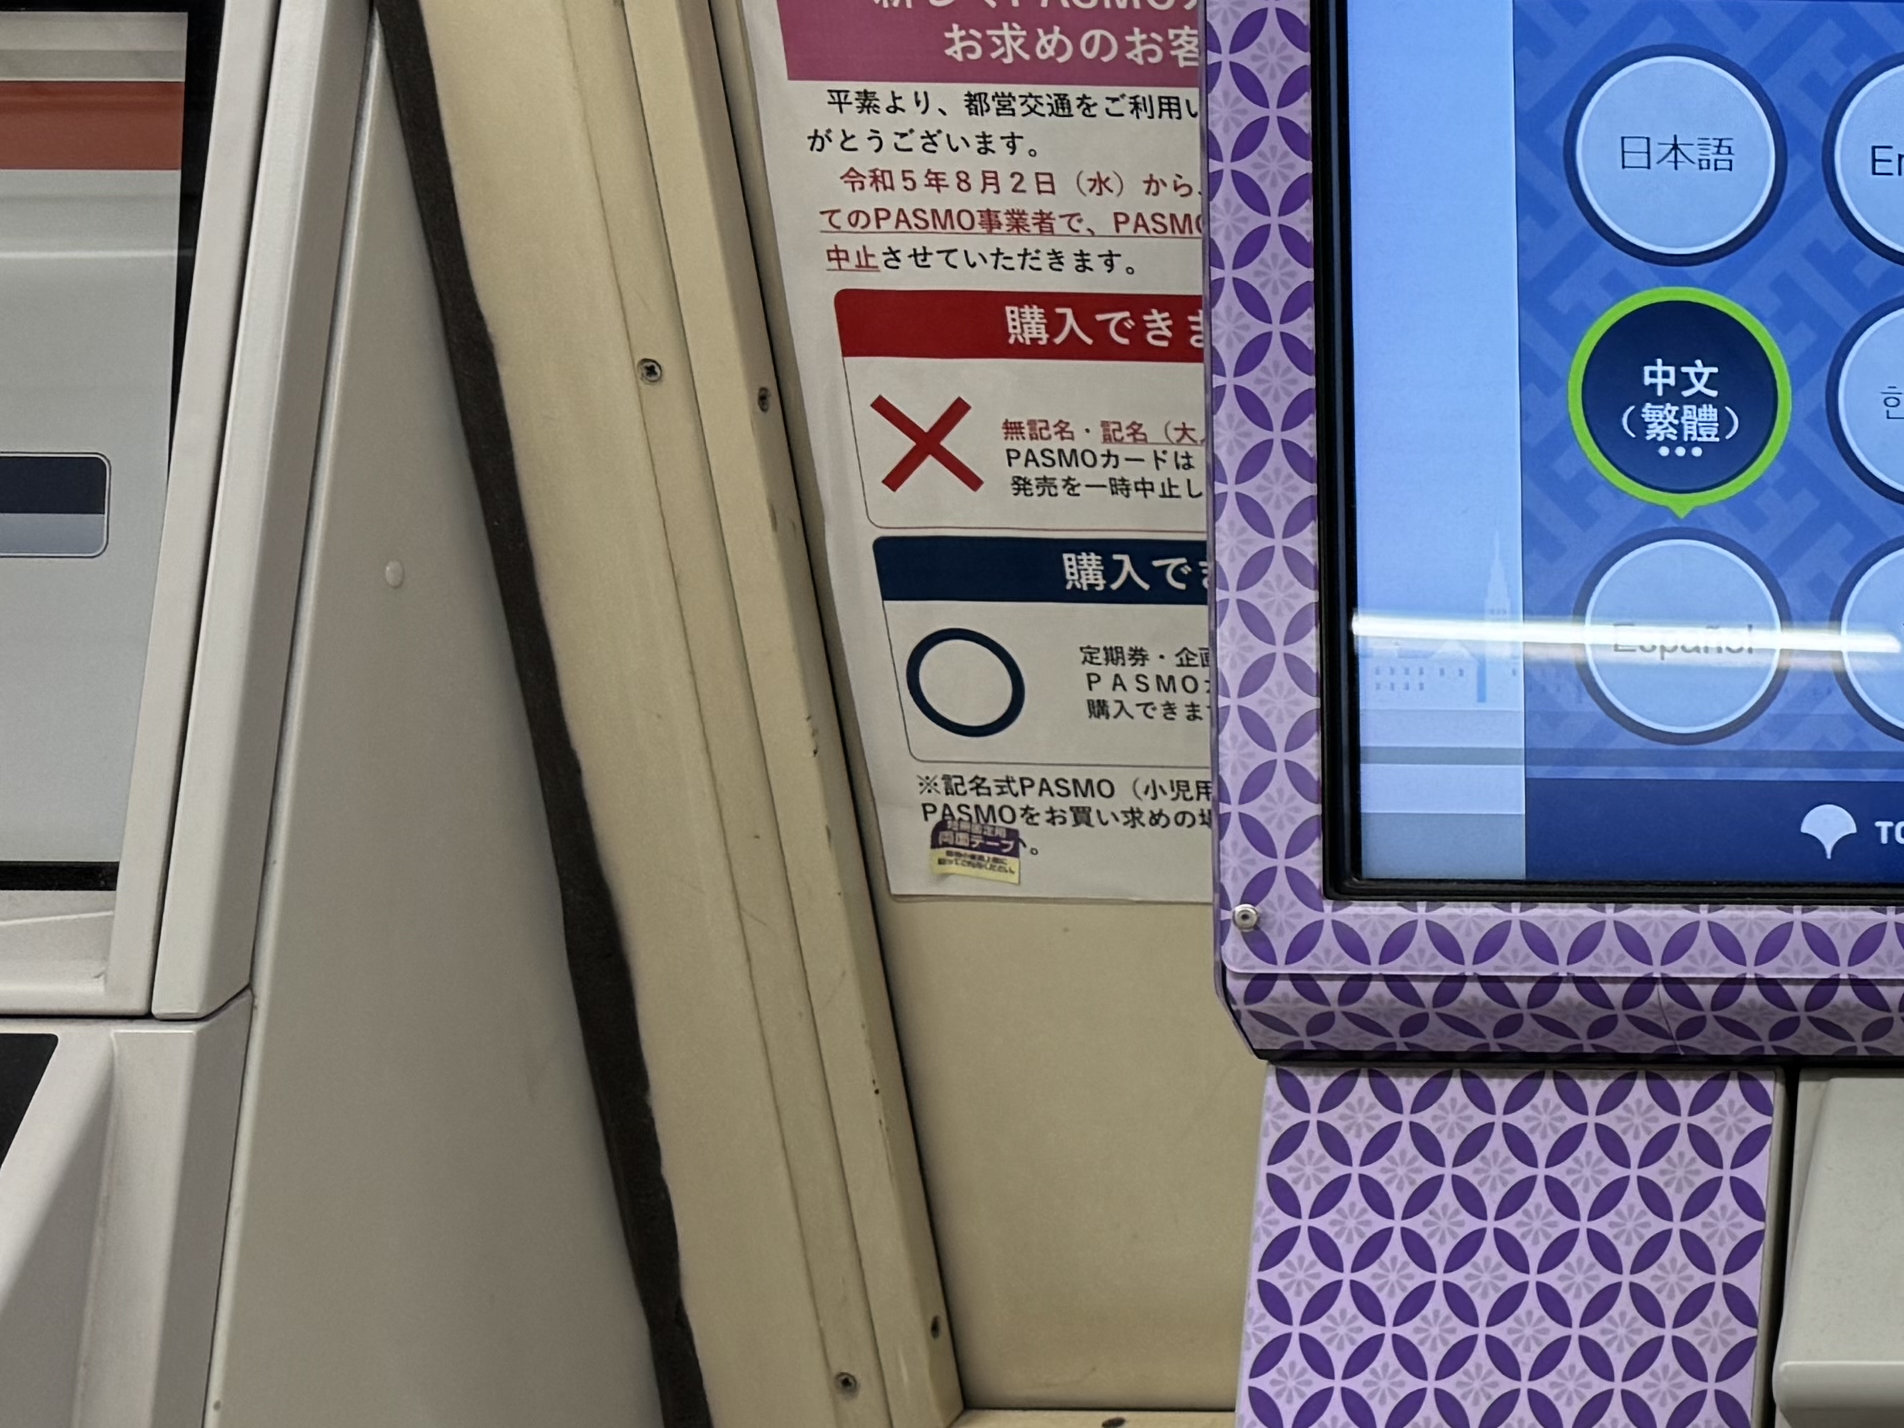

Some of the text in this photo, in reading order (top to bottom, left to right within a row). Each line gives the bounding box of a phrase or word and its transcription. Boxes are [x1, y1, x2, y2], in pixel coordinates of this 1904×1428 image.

[807, 128, 1039, 159] がとうございます。
[1619, 135, 1736, 174] 日本語
[819, 207, 1202, 236] てのPASMO事業者で、PASM
[825, 243, 1136, 276] 中止させていただきます。
[1643, 359, 1720, 399] 中文
[1002, 420, 1206, 445] 無記名・記名（大
[1005, 448, 1196, 471] PASMOカードは
[1010, 475, 1203, 499] 発売を一時中止し
[1086, 673, 1211, 694] PASMO
[1087, 699, 1211, 722] 購入できま
